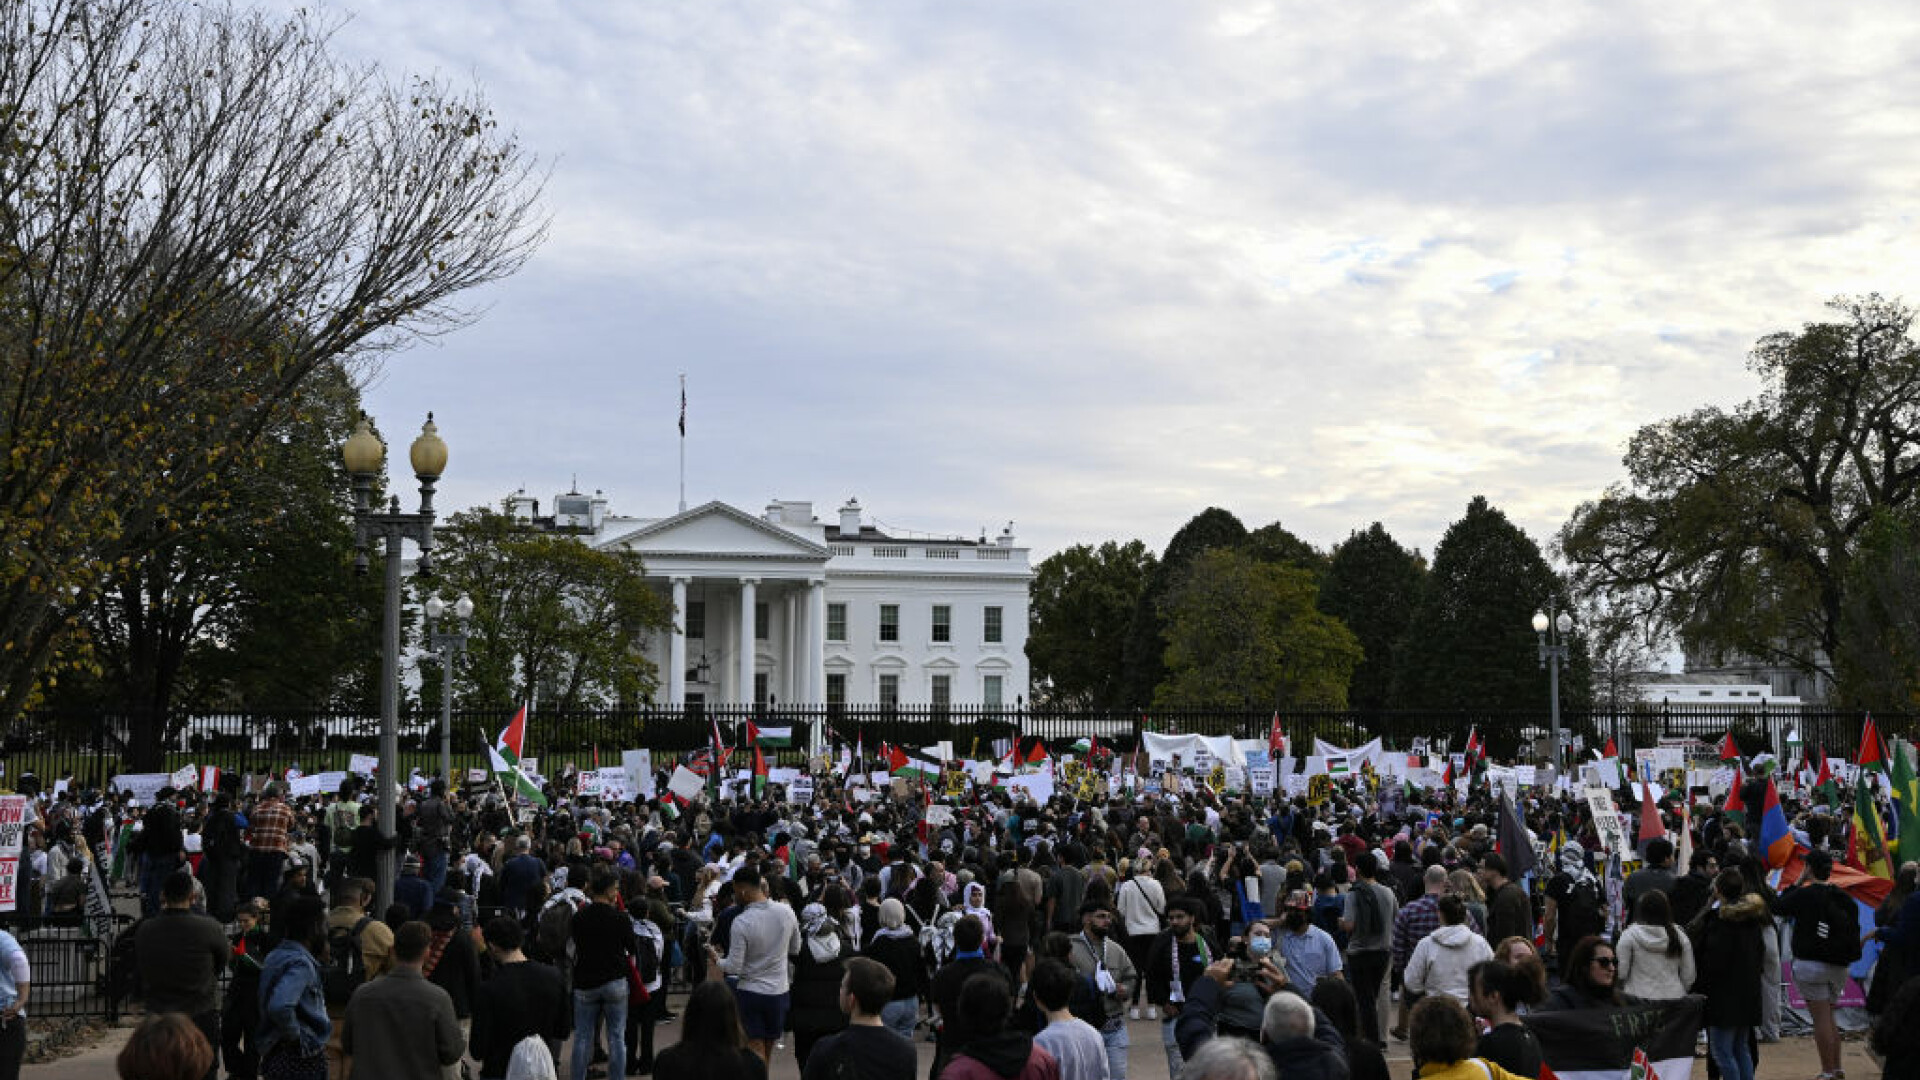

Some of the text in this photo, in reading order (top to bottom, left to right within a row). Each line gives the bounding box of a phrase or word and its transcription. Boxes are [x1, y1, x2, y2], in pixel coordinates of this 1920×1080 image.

[0, 808, 21, 822] OW
[0, 831, 17, 846] VE!
[0, 862, 13, 875] ZA
